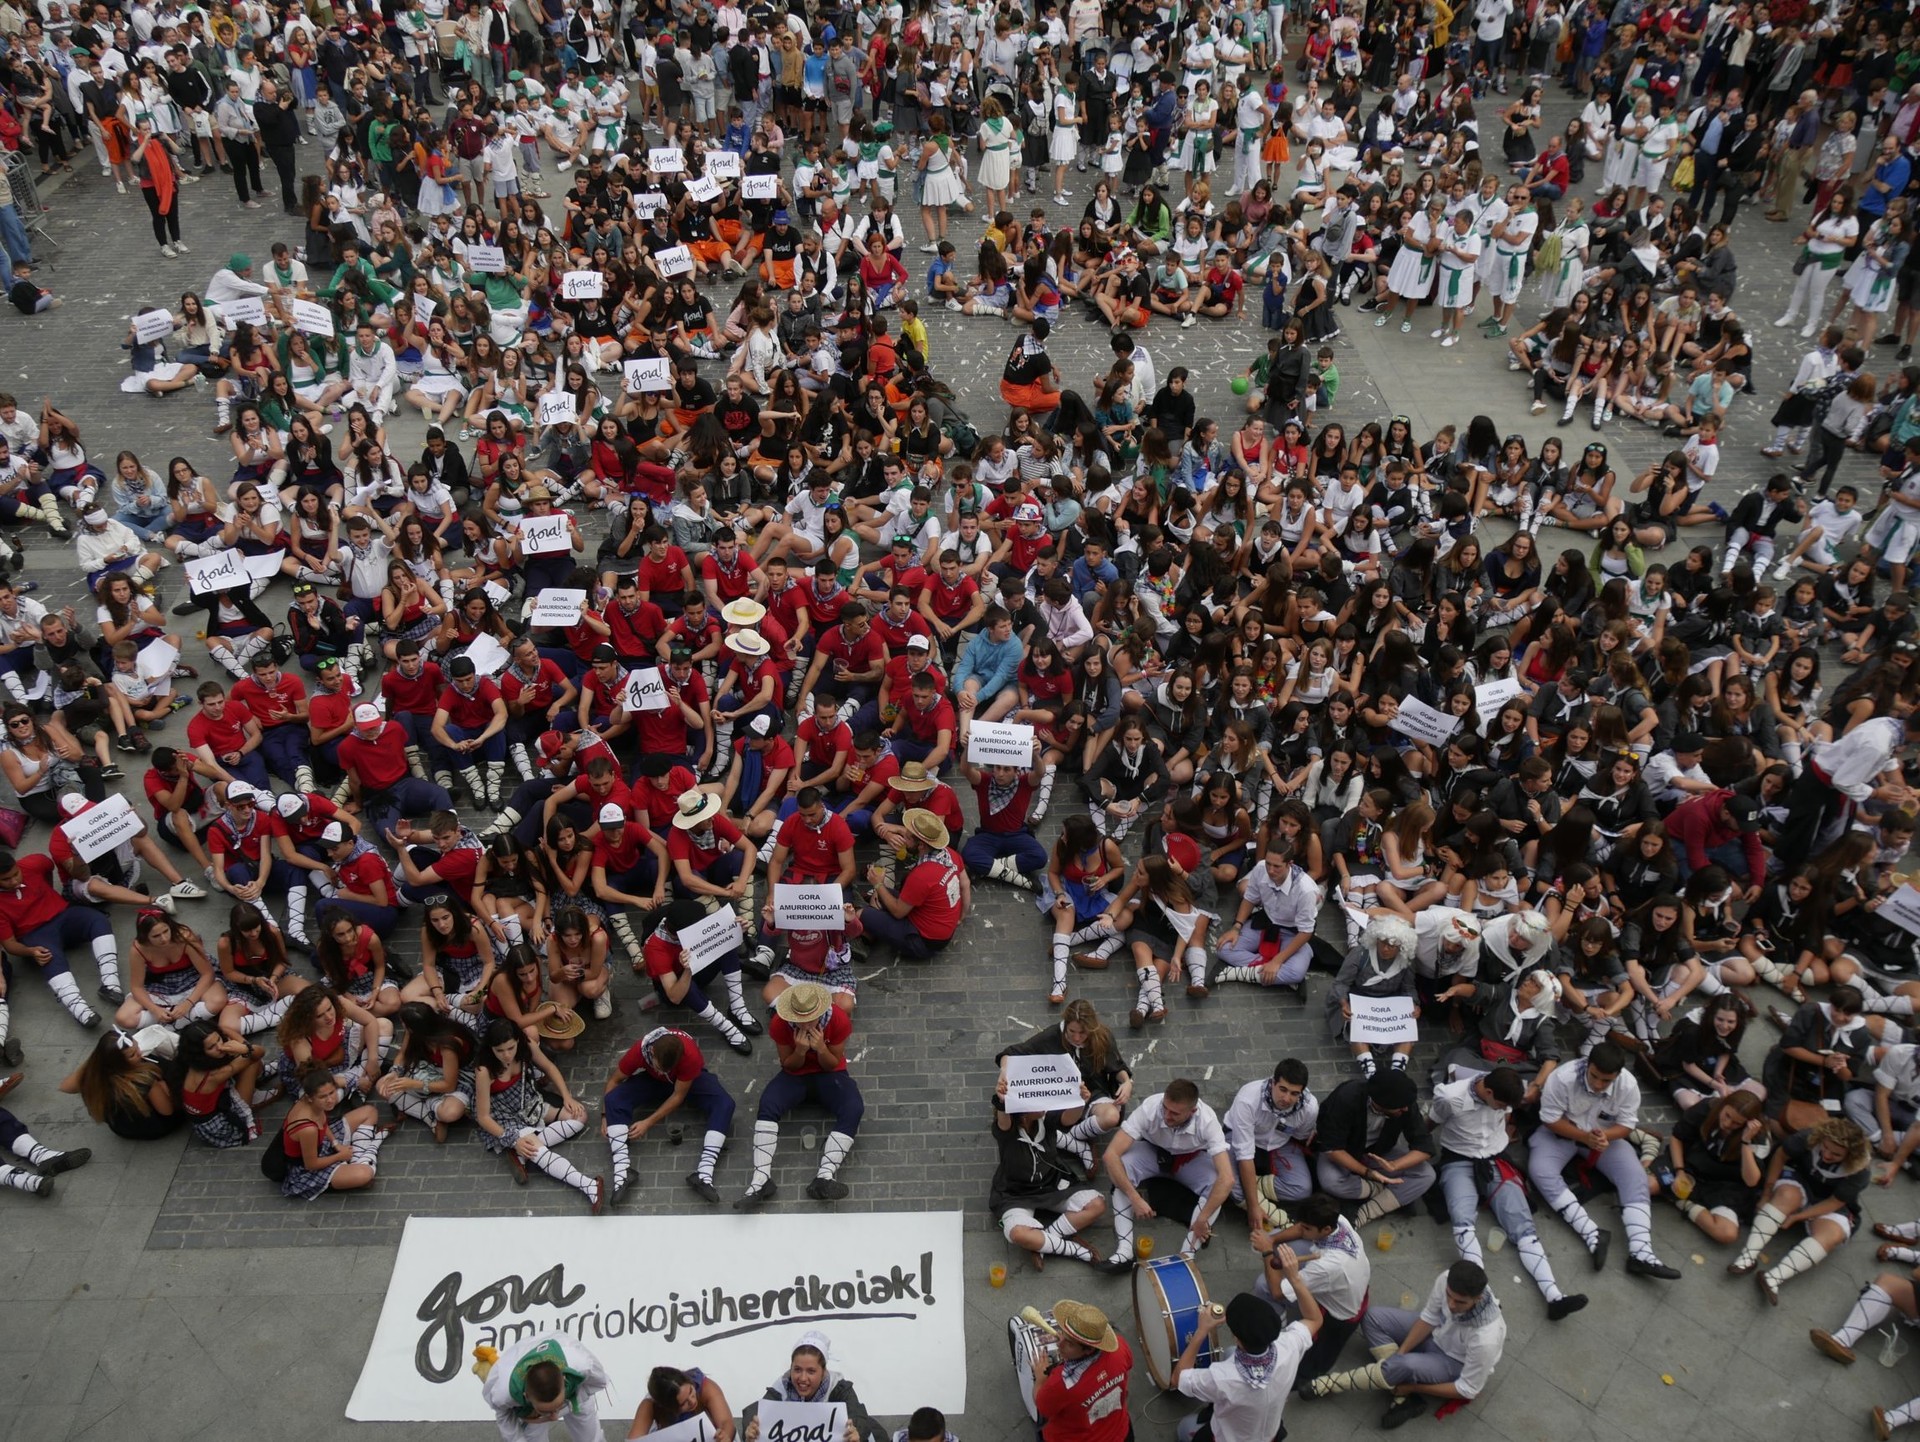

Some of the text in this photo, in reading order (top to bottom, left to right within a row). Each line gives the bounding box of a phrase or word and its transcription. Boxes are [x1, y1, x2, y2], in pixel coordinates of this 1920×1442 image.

[654, 149, 677, 170] gora!
[710, 153, 734, 175] gora!
[747, 176, 771, 197] gora!
[638, 195, 662, 218] gora!
[663, 248, 686, 275] gora!
[568, 274, 597, 297] gora!
[632, 360, 663, 391] gora!
[542, 395, 571, 424] gora!
[528, 518, 563, 551] gora!
[198, 553, 237, 591] gora!
[1400, 711, 1438, 731] AMURRIOKO
[1419, 711, 1437, 723] GORA
[1400, 719, 1438, 740] HERRIKOIAK
[973, 737, 1017, 746] AMURRIOKO
[979, 747, 1023, 756] HERRIKOIAK
[88, 811, 109, 826] GORA
[78, 816, 119, 844] AMURRIOKO
[88, 821, 131, 848] HERRIKOIAK
[690, 922, 738, 952] AMURRIOKO JAI
[702, 922, 720, 935] GORA
[696, 934, 735, 960] HERRIKOIAK
[1356, 1013, 1398, 1023] AMURRIOKO
[1362, 1024, 1407, 1033] HERRIKOIAK
[1031, 1065, 1057, 1073] GORA
[1010, 1076, 1063, 1087] AMURRIOKO
[1018, 1088, 1072, 1099] HERRIKOIAK
[415, 1263, 586, 1383] gora
